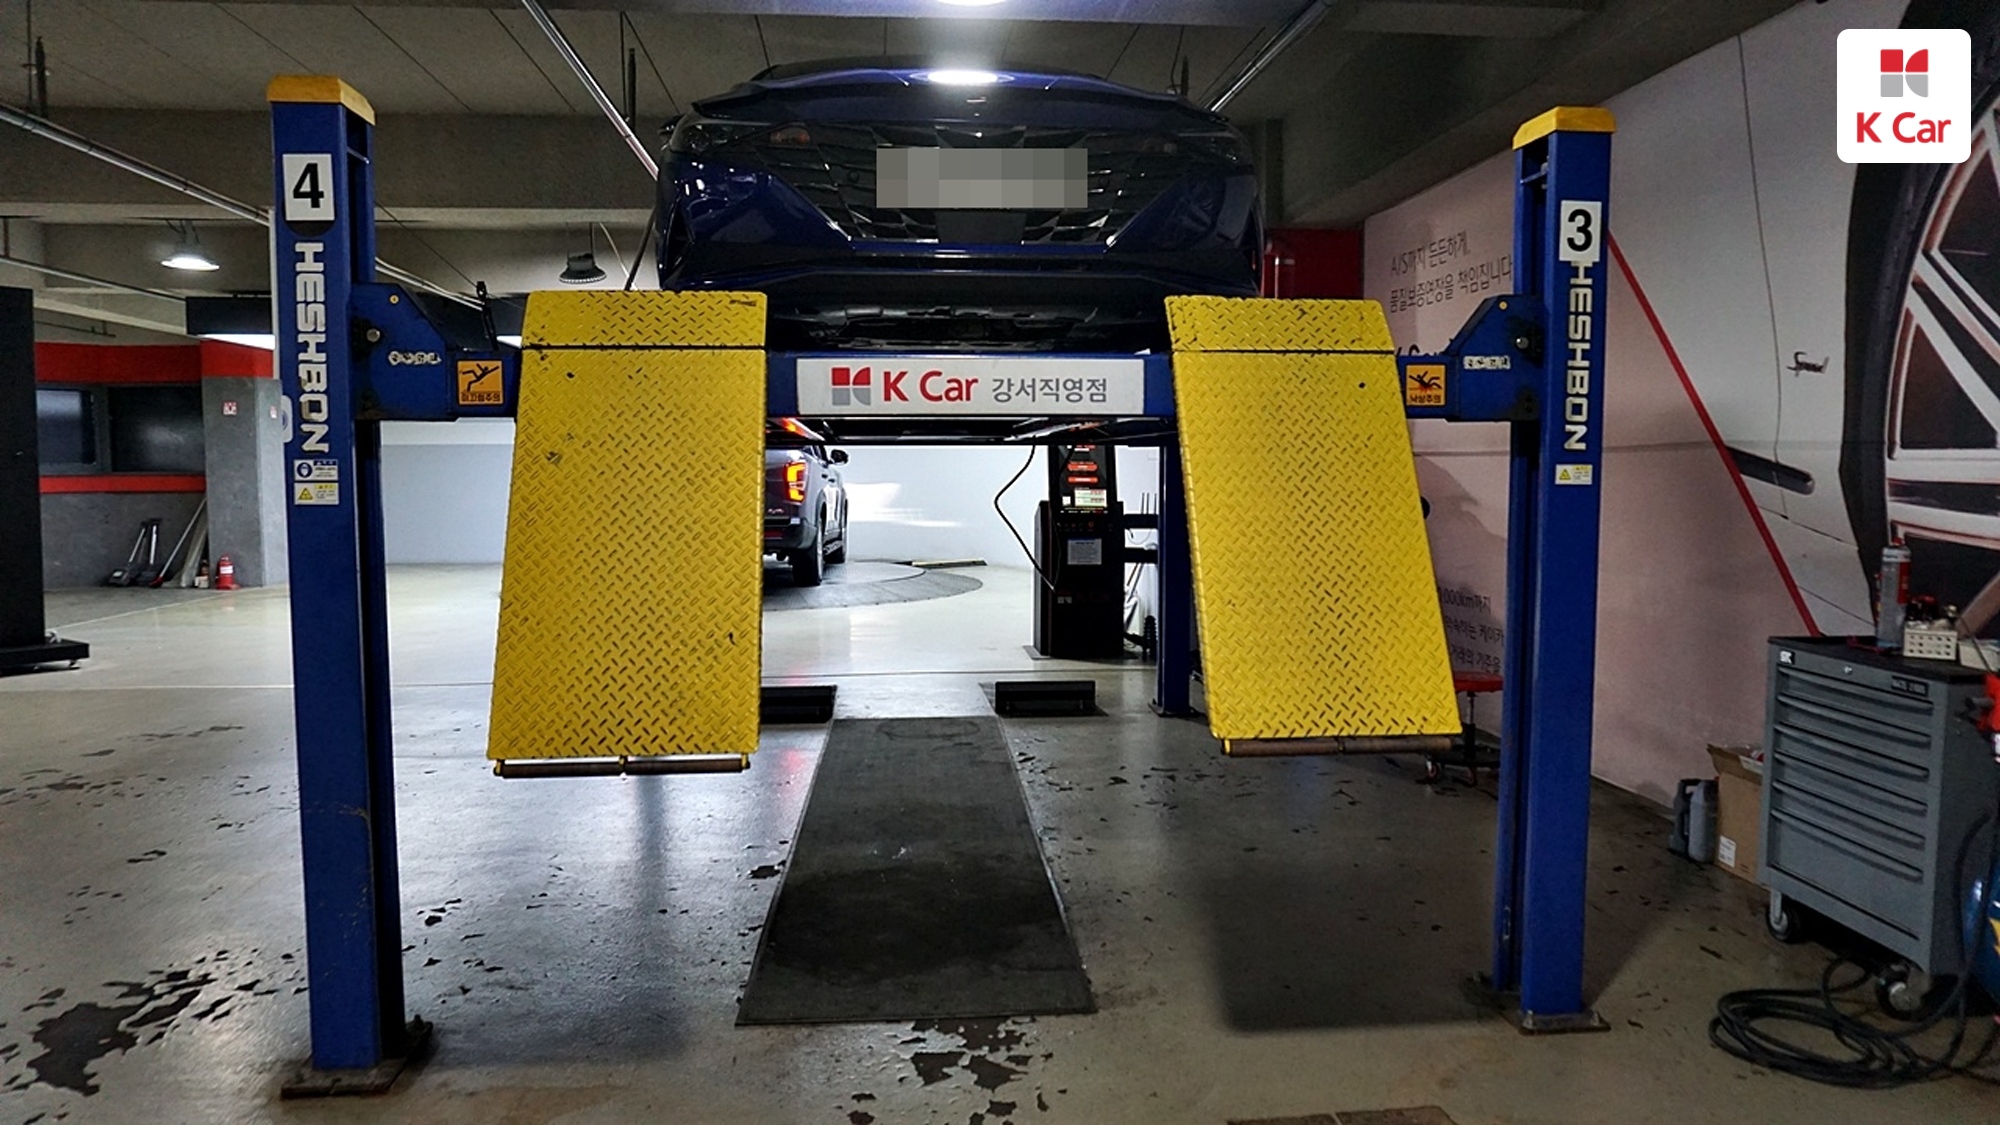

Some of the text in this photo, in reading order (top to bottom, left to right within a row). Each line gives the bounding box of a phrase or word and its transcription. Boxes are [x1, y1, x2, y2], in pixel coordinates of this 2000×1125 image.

[292, 162, 325, 209] 4
[1566, 208, 1593, 252] 3
[294, 242, 330, 454] HESHBON
[1563, 260, 1594, 451] HESHBON
[883, 370, 1107, 403] K Car 강서직영점
